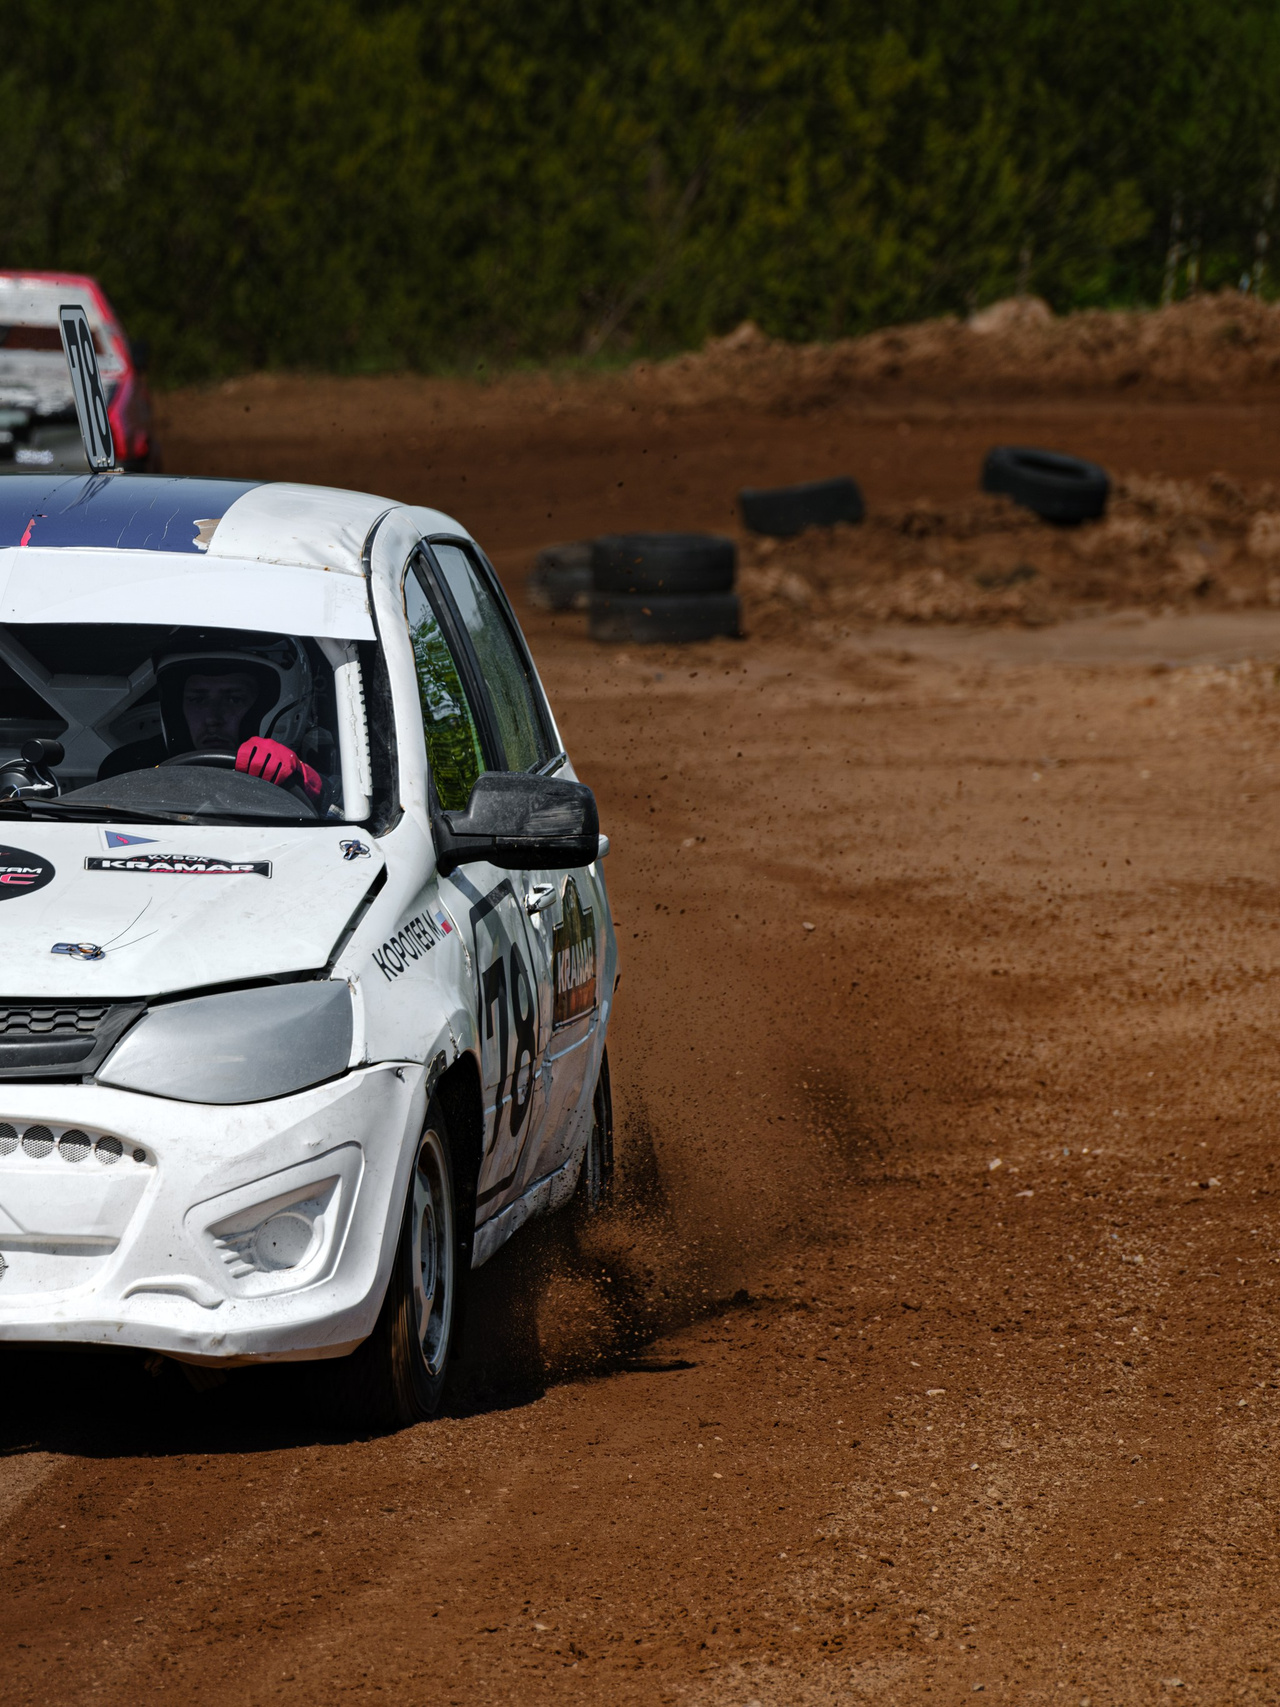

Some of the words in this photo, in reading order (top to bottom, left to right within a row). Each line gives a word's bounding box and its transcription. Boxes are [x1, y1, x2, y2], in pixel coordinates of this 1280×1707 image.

[62, 318, 112, 458] 78
[101, 860, 255, 872] KRAMAR
[371, 917, 436, 982] КОРОЛЕВ
[557, 936, 594, 994] KRAMAR
[482, 941, 535, 1156] 78
